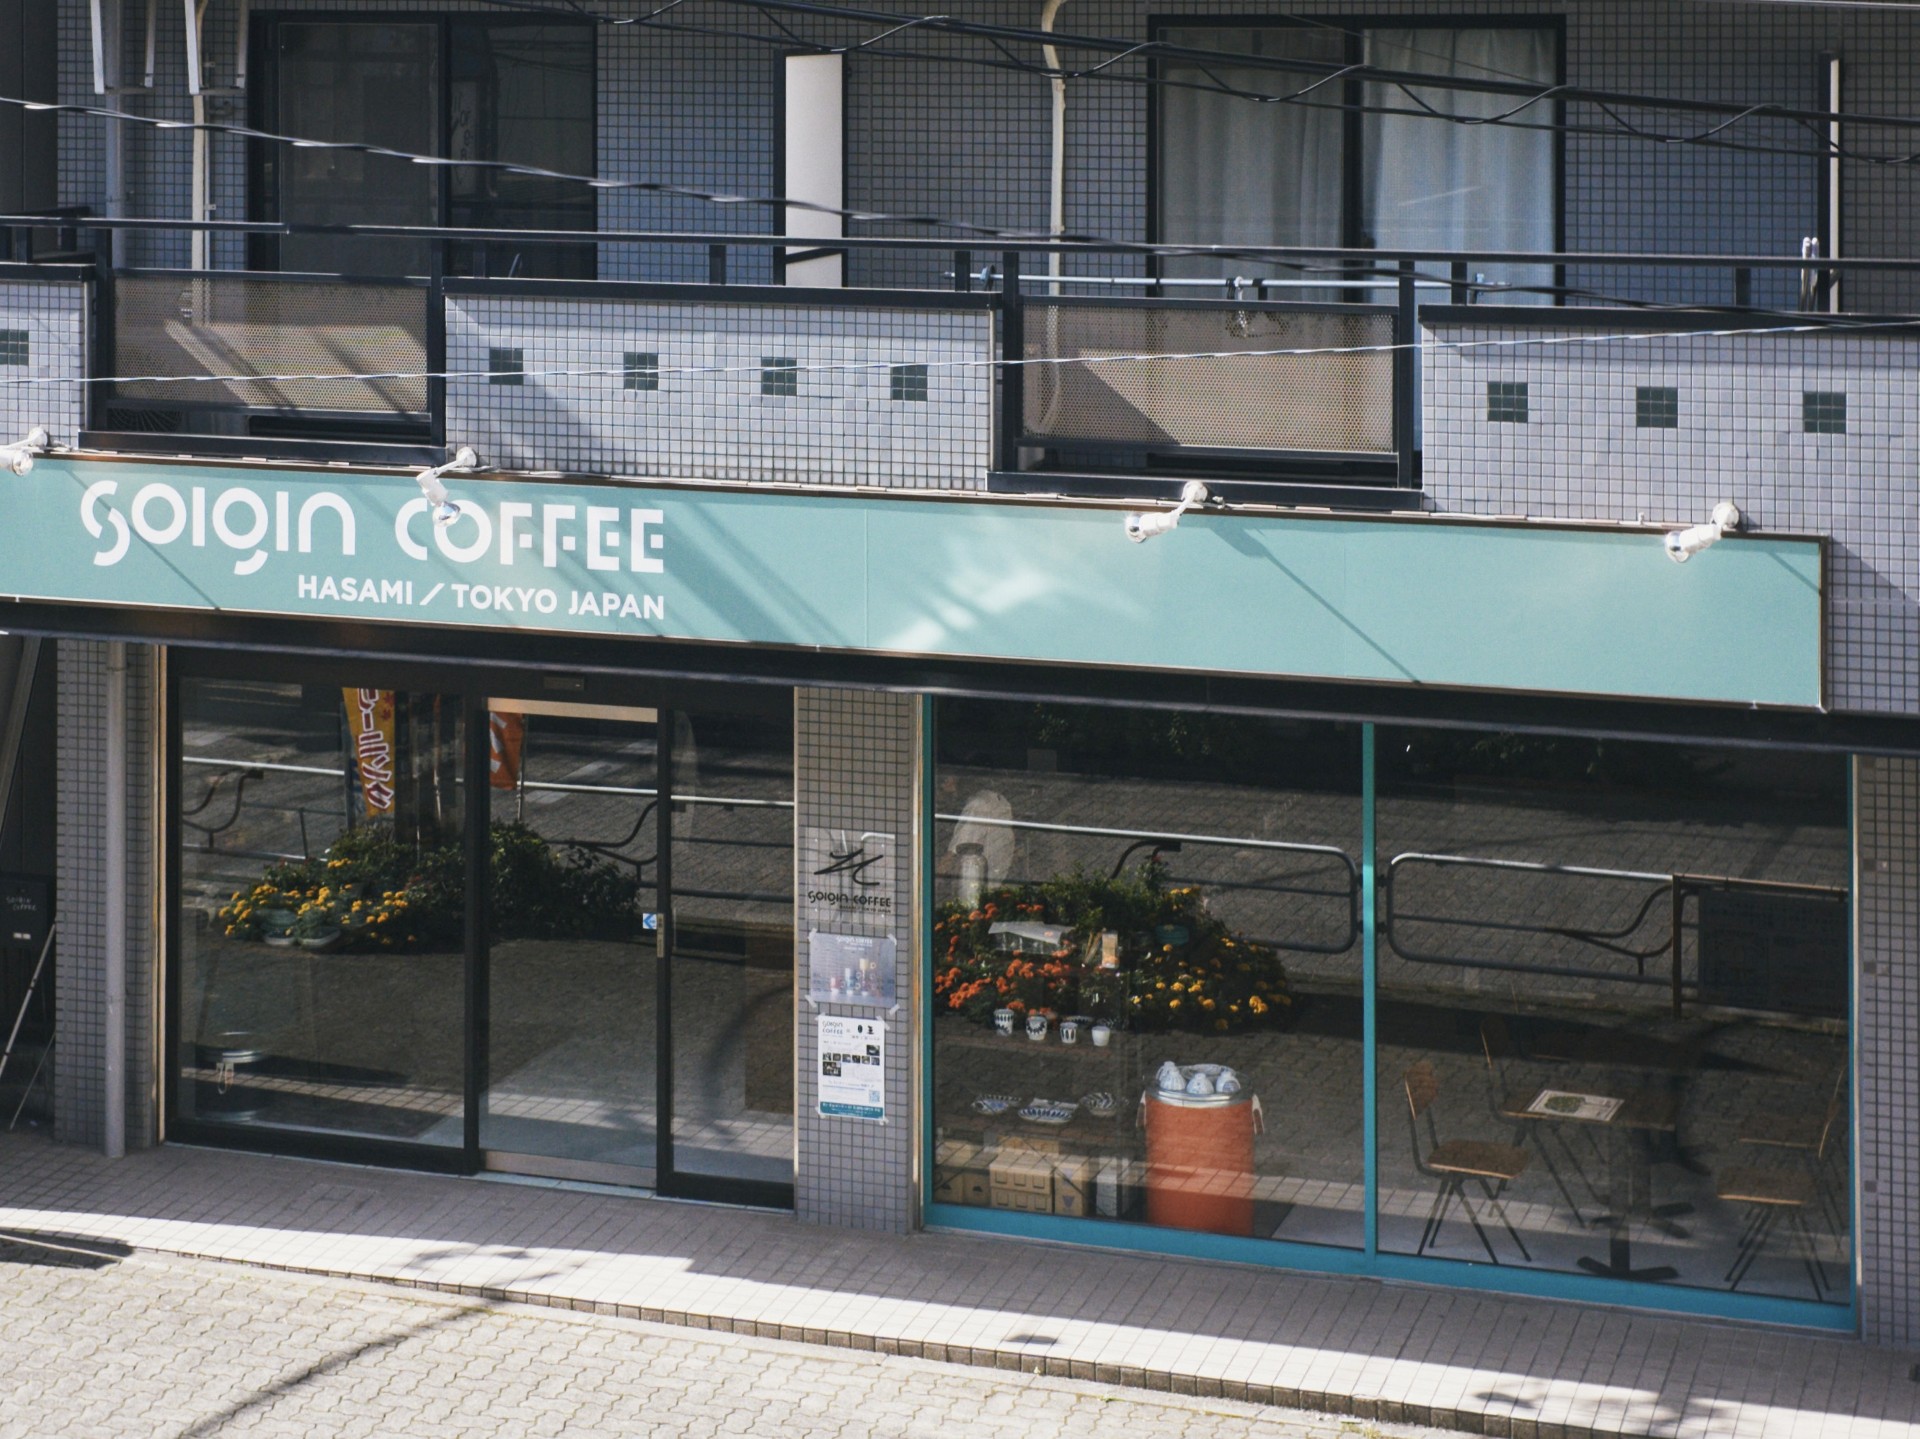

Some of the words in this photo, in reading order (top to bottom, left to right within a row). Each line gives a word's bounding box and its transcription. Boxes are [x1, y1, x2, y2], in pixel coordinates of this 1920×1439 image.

[395, 498, 664, 573] COFFEE
[298, 574, 412, 606] HASAMI
[451, 583, 558, 614] TOKYO
[568, 590, 664, 620] JAPAN
[853, 895, 891, 907] COFFEE
